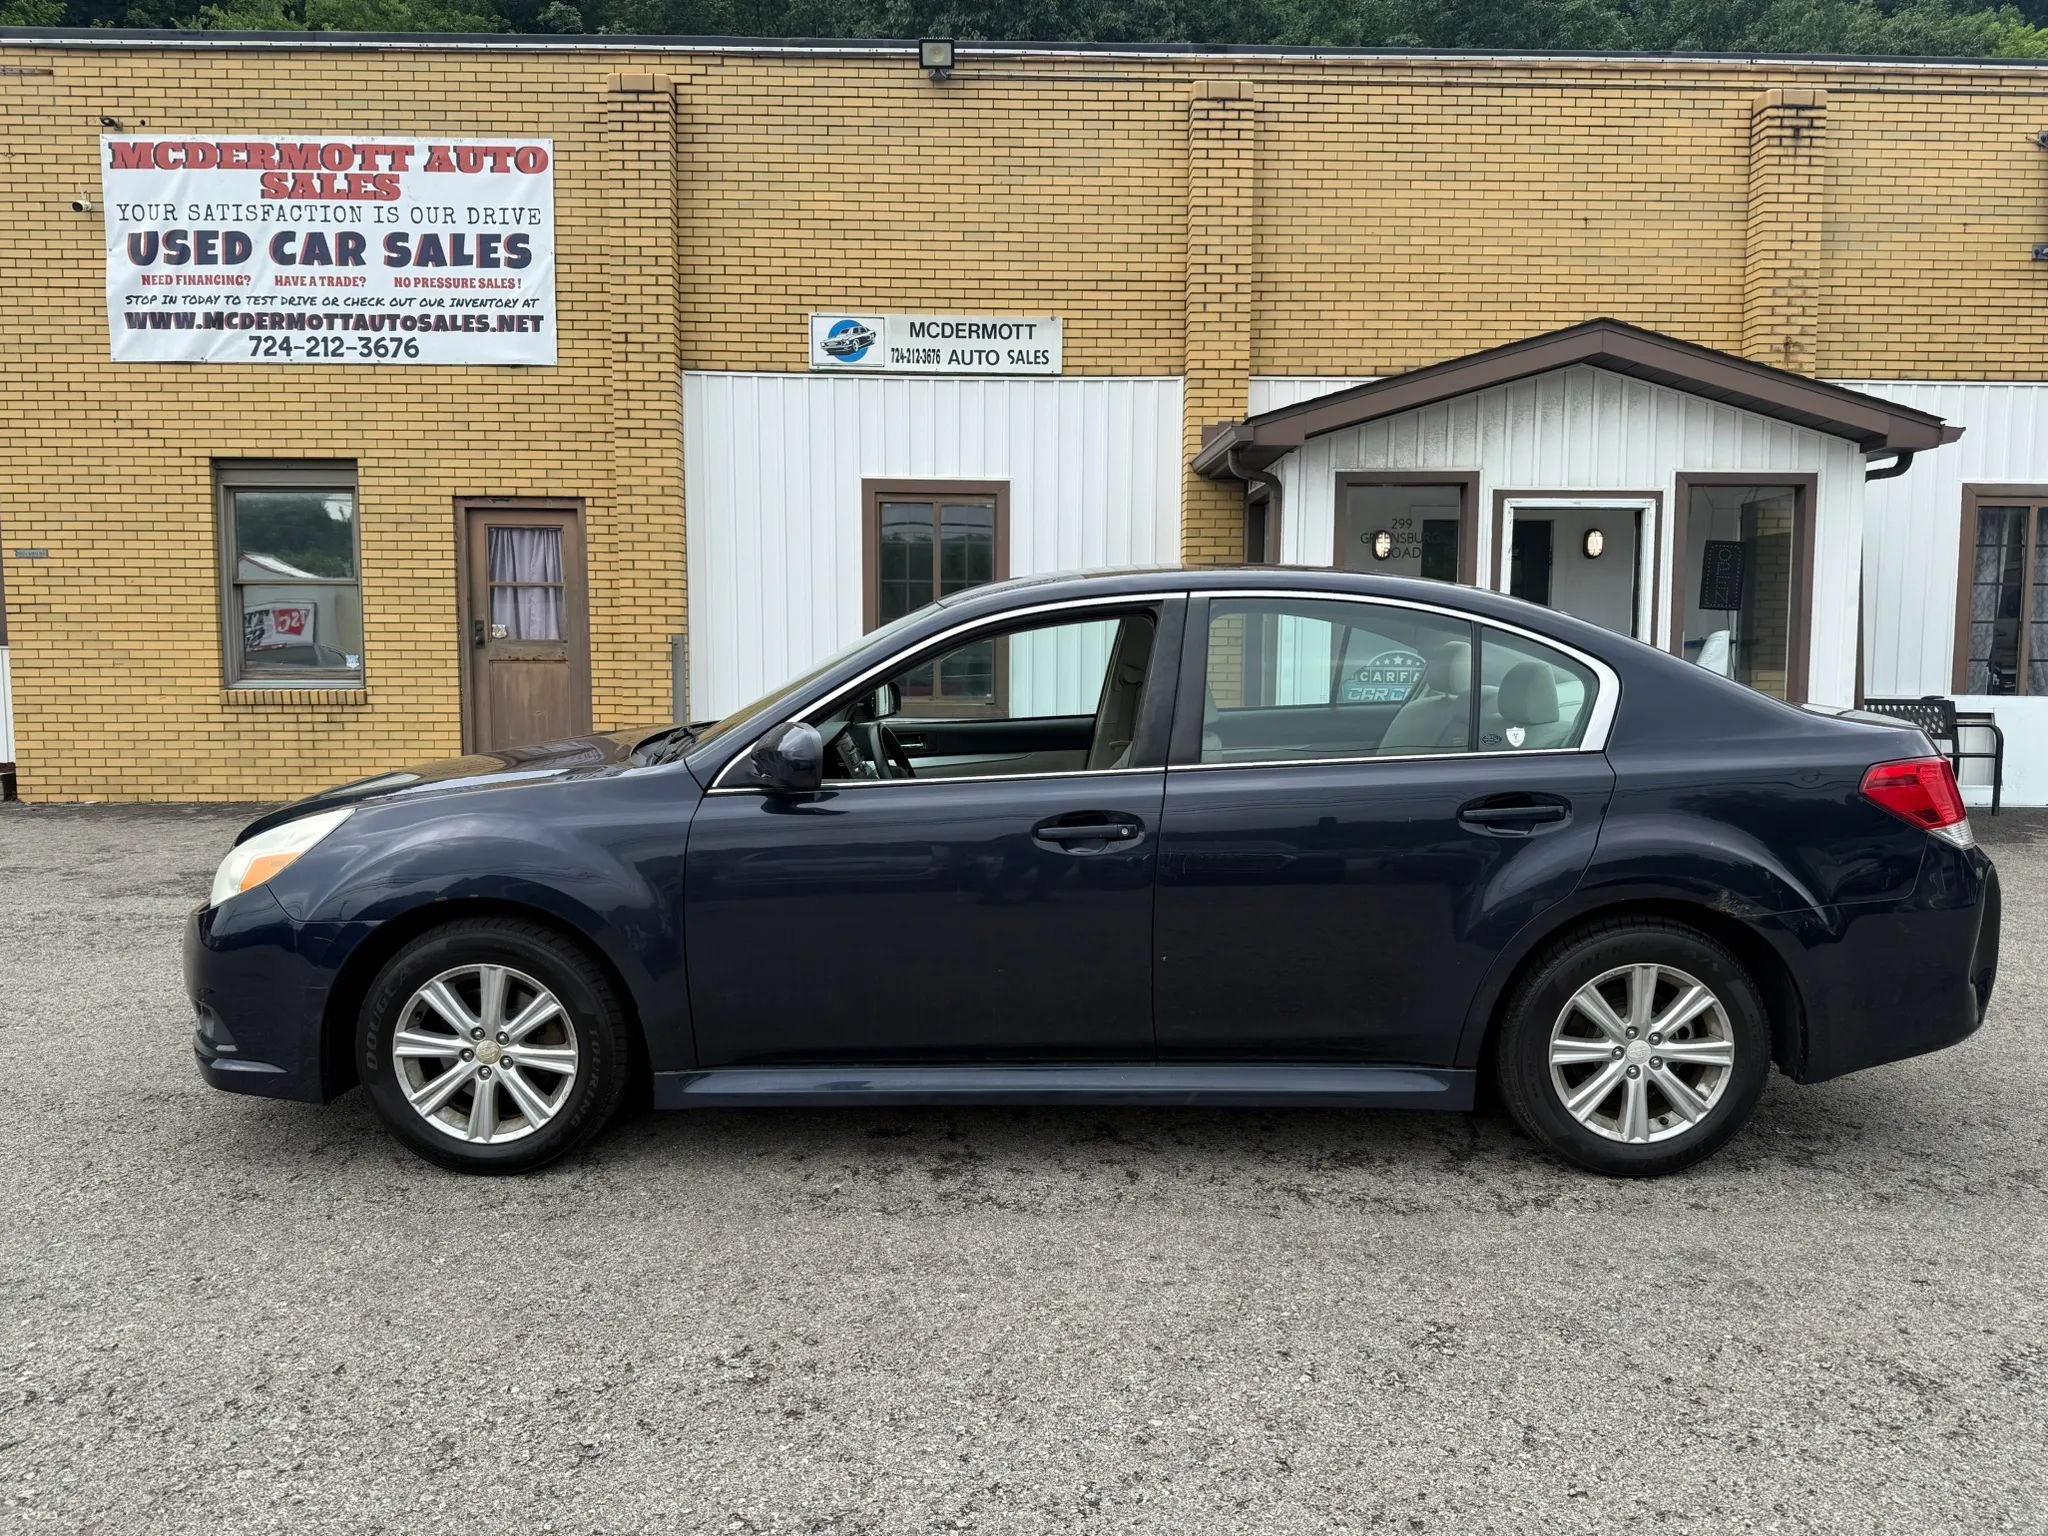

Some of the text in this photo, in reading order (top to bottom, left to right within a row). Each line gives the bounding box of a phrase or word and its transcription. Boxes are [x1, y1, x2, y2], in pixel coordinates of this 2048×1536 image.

[108, 141, 549, 174] MCDERMOTT AUTO
[260, 171, 402, 201] SALES
[116, 203, 541, 225] YOUR SATISFACTION IS OUR DRIVE
[127, 229, 533, 269] USED CAR SALES
[141, 274, 252, 286] NEED FINANCING?
[274, 275, 367, 288] HAVE A TRADE?
[394, 278, 411, 289] NO
[413, 278, 477, 289] PRESSURE
[125, 294, 540, 308] STOP IN TODAY TO TEST DRIVE OR CHECK OUT OUR INVENTORY AT
[124, 311, 544, 333] WWW.MCDERMOTTAUTOSALES.NET
[909, 321, 1037, 340] MCDERMOTT
[249, 335, 420, 359] 724-212-3676
[890, 347, 941, 365] 724-212-3676
[947, 349, 1049, 366] AUTO SALES
[1391, 518, 1413, 530] 299
[1714, 548, 1733, 605] OPEN
[1359, 671, 1421, 682] CARFA
[366, 965, 413, 1071] DOUGLA
[570, 1028, 604, 1128] TOURING
